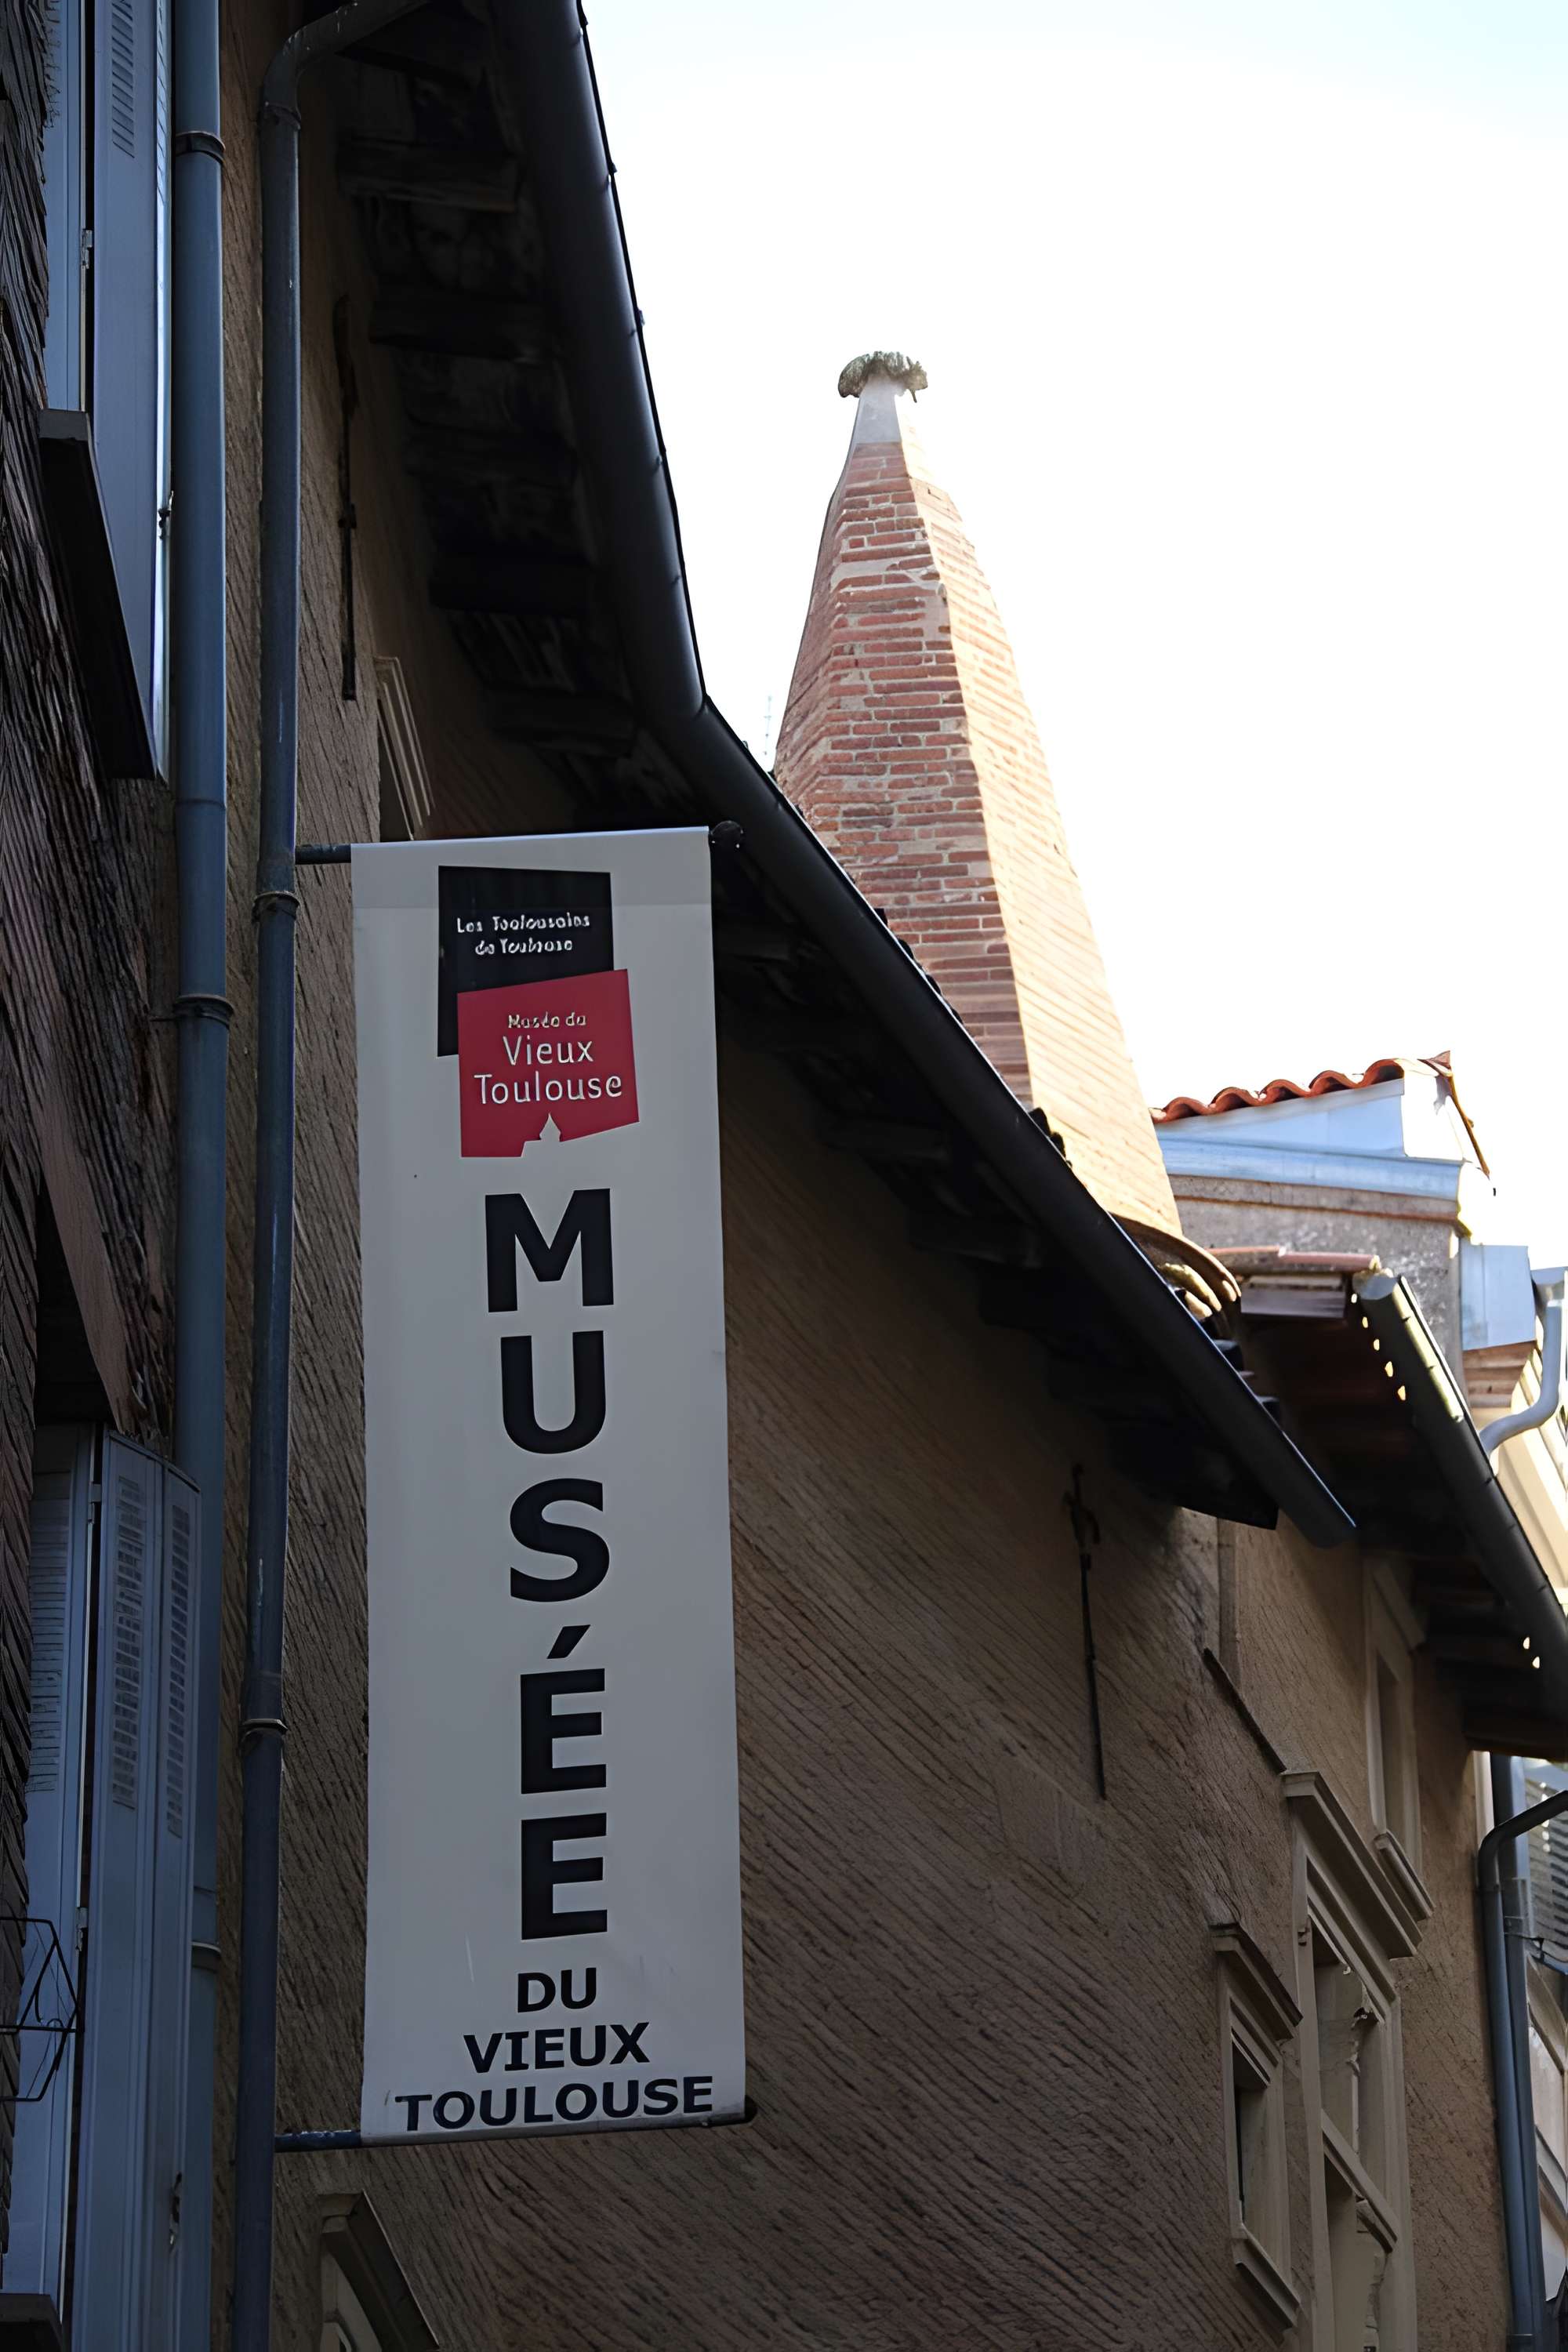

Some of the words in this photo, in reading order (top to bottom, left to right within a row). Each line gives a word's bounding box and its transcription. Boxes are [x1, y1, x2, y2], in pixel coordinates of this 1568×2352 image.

[503, 1034, 593, 1065] Vieux
[474, 1071, 622, 1105] Toulouse
[485, 1188, 614, 1941] MUSÉE
[517, 1967, 597, 2013] DU
[463, 2021, 651, 2074] VIEUX
[394, 2075, 713, 2132] TOULOUSE
